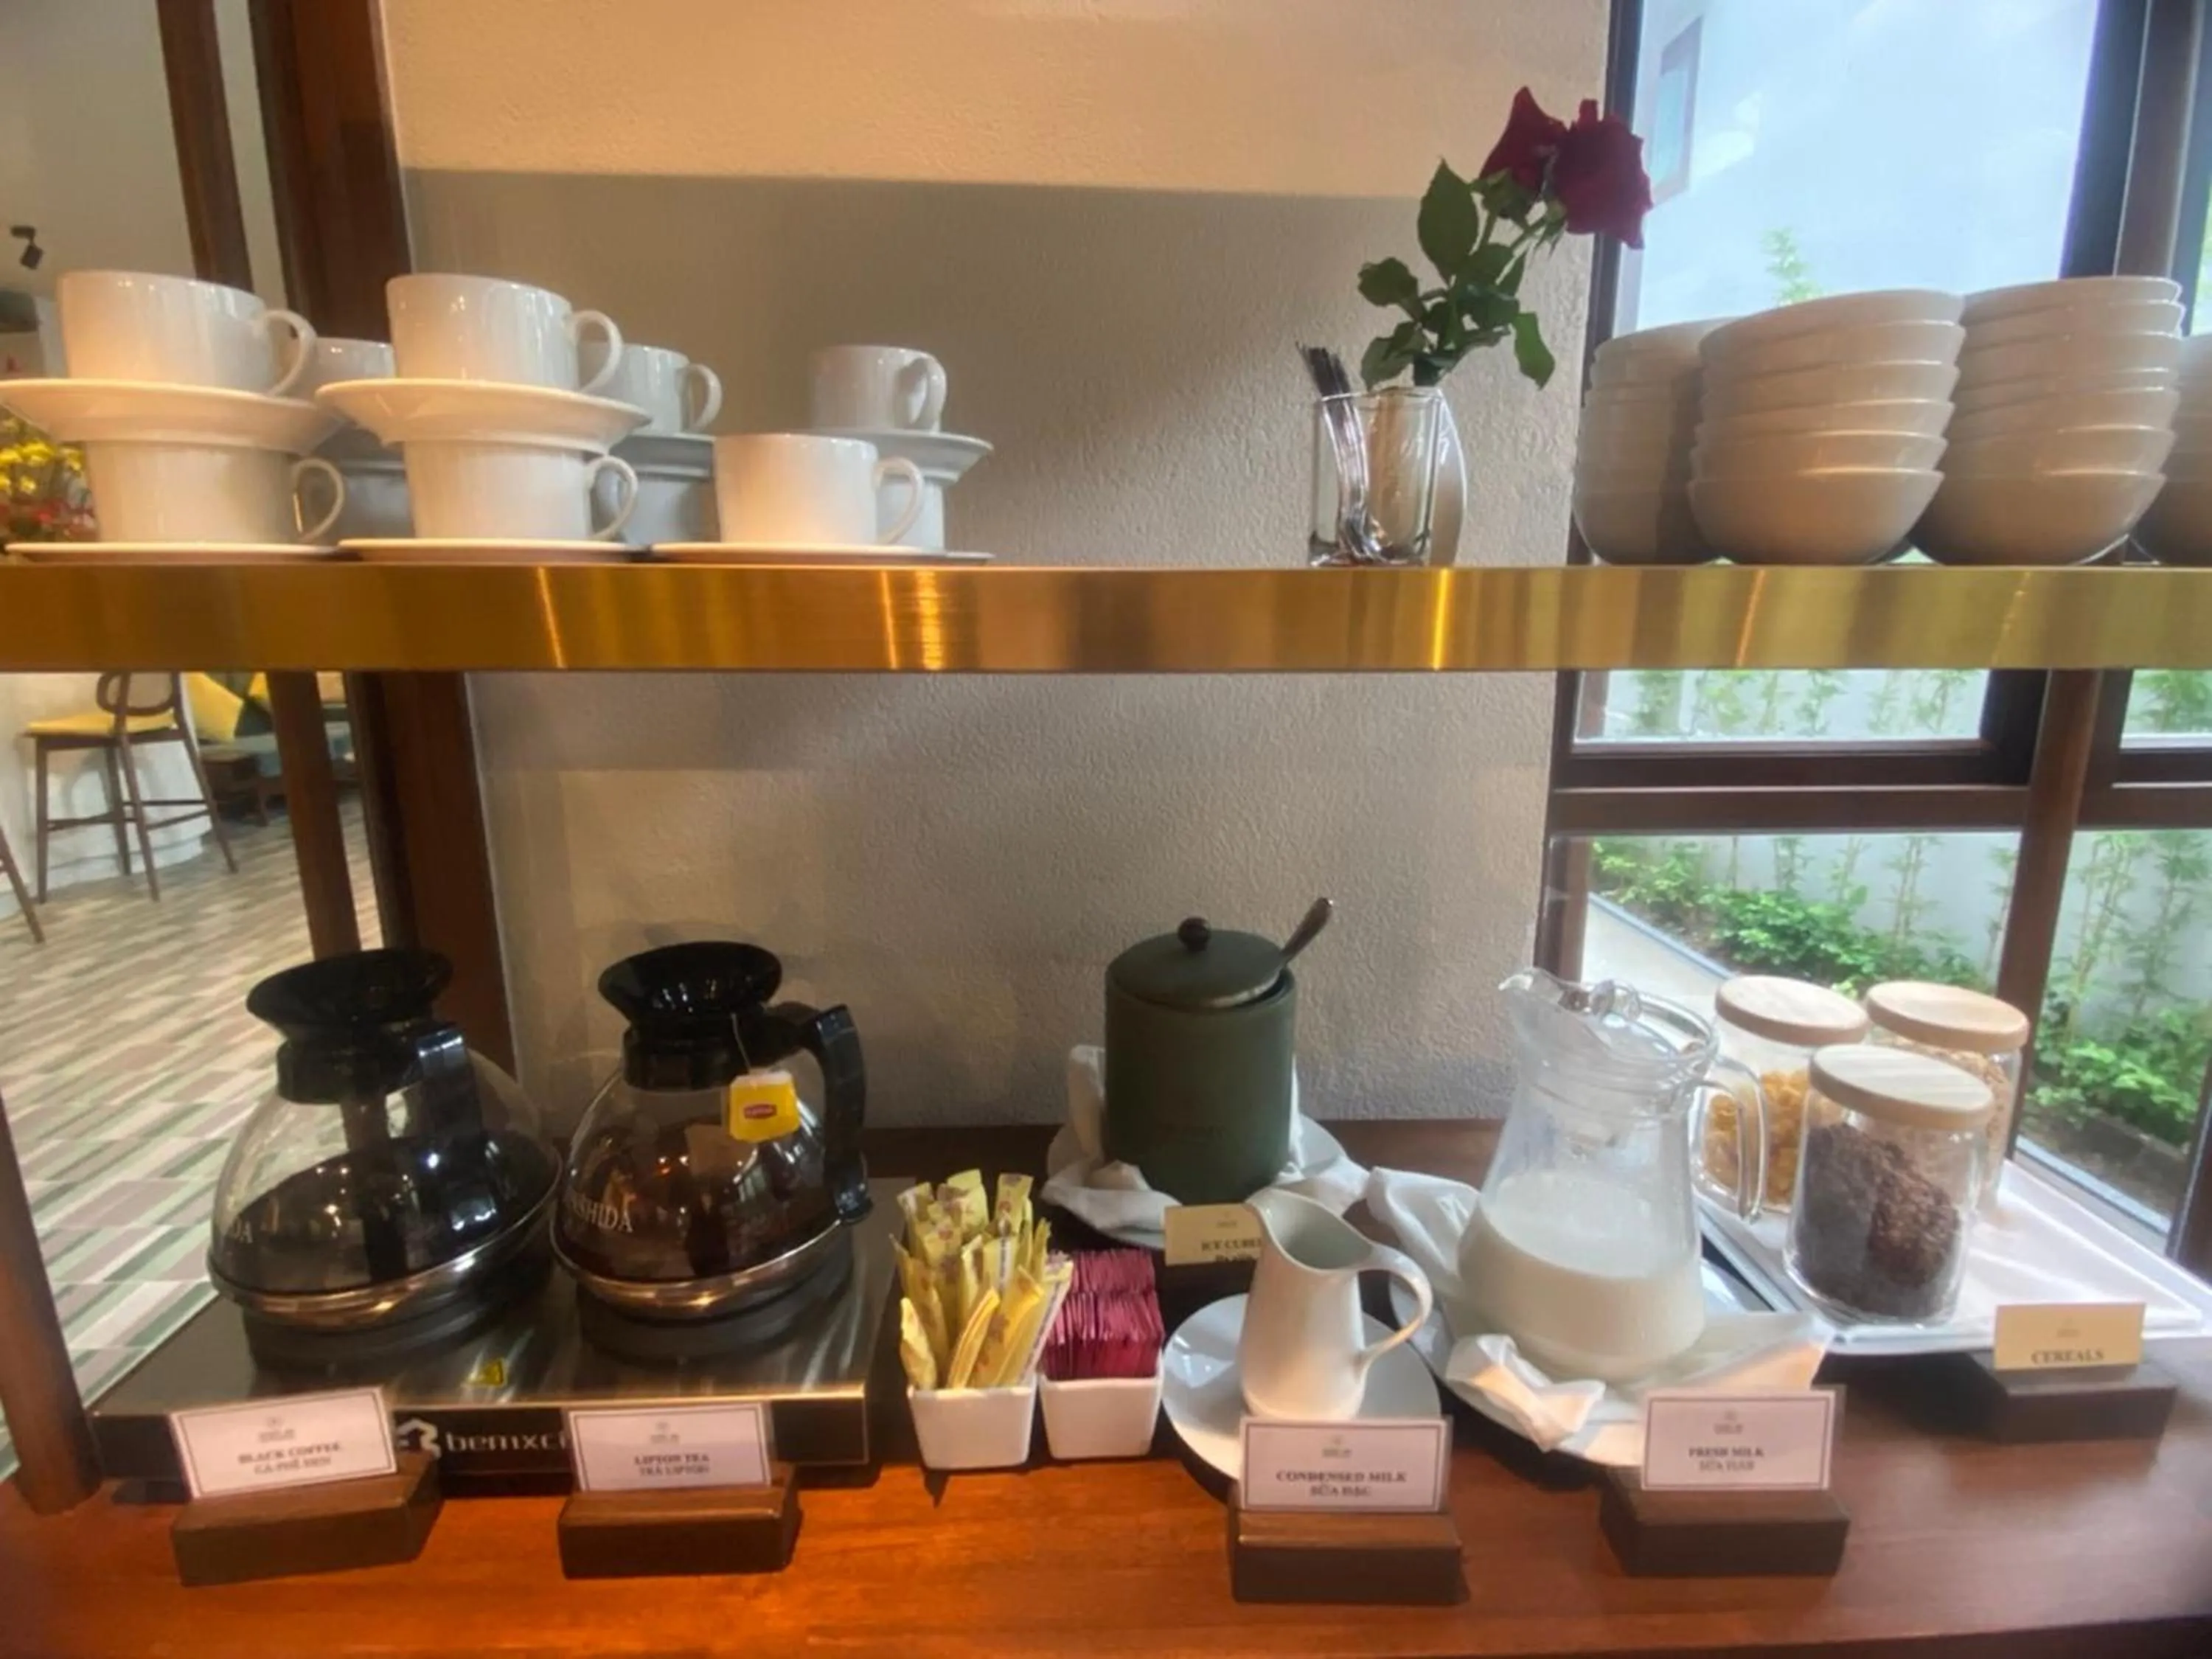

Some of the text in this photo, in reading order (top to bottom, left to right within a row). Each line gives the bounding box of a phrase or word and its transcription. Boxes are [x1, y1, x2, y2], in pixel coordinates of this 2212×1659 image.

[2031, 1348, 2104, 1363] CEREALS
[238, 1442, 340, 1464] BLACK COFFEE
[1688, 1447, 1764, 1458] FRESH MILK
[1276, 1470, 1407, 1483] CONDENSED MILK
